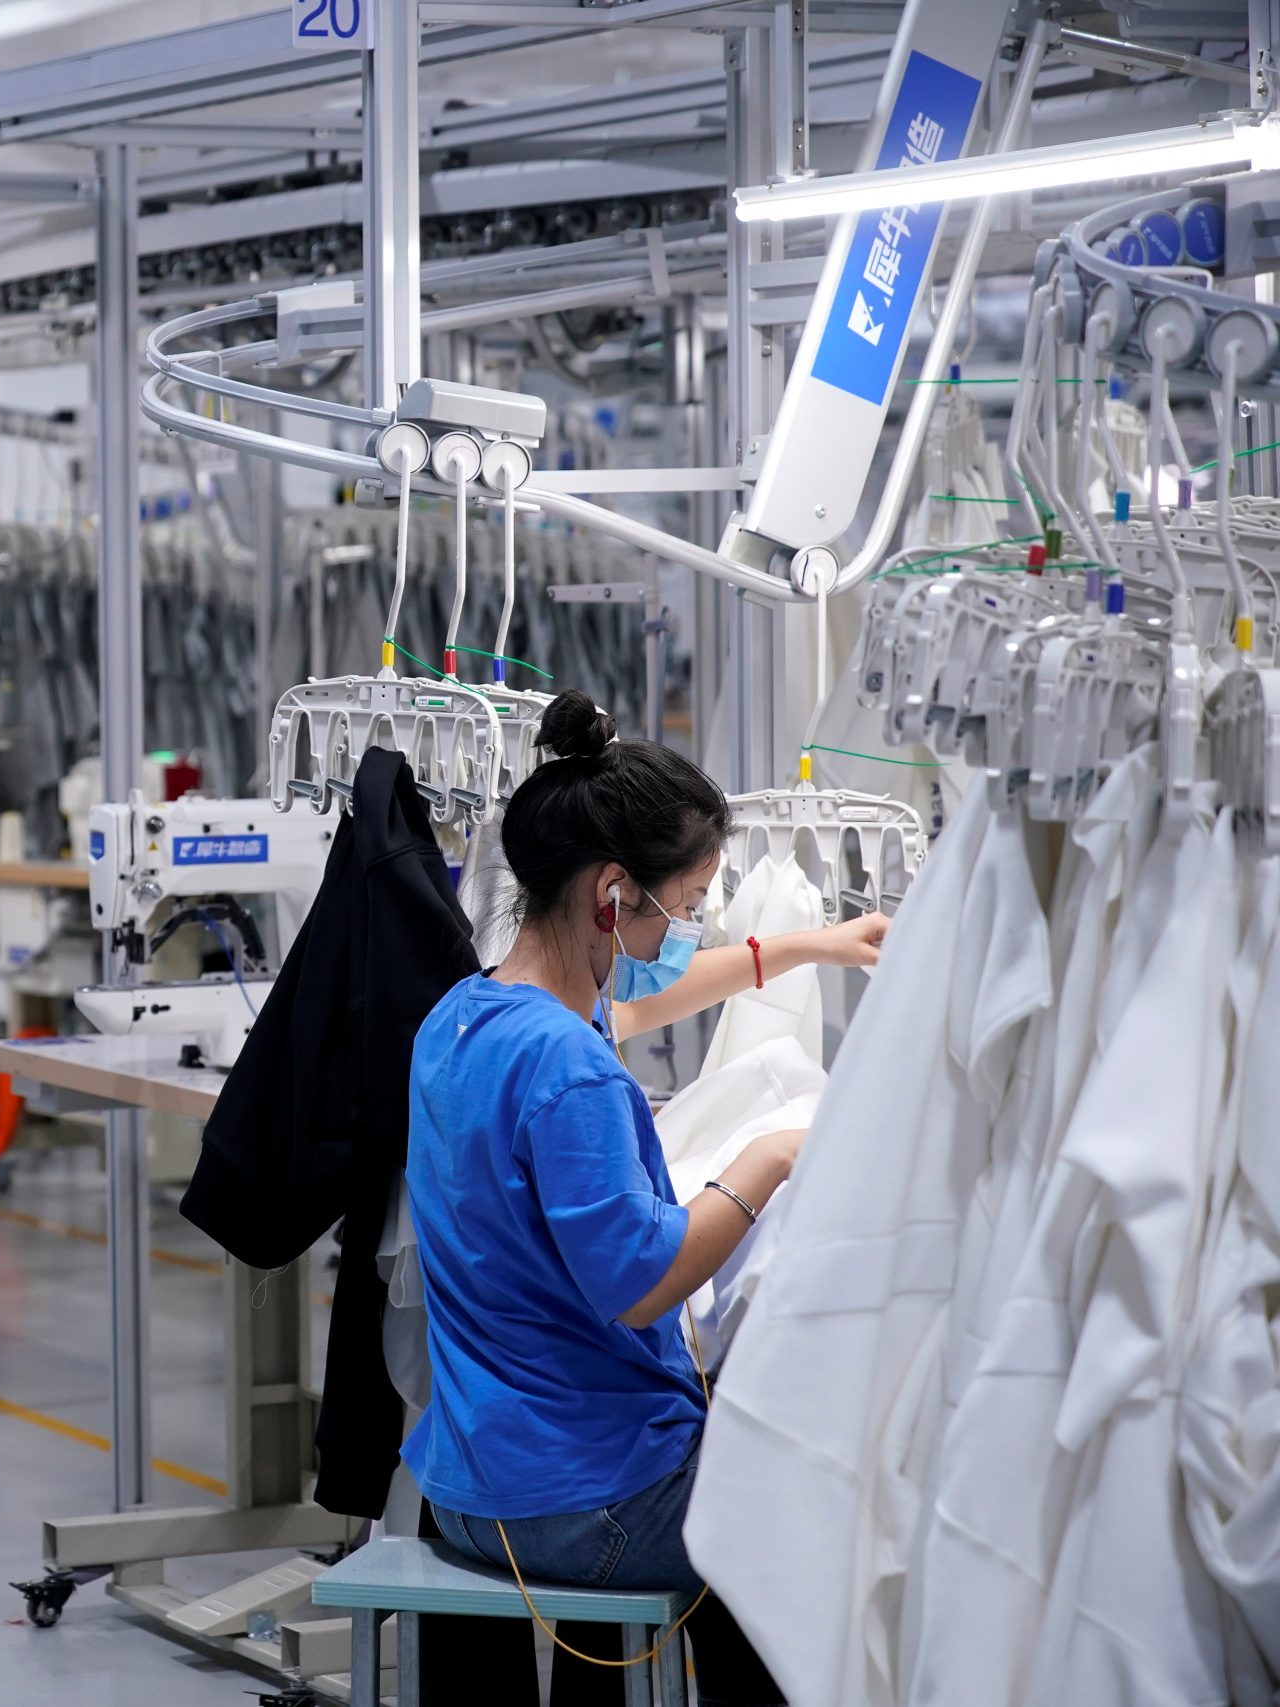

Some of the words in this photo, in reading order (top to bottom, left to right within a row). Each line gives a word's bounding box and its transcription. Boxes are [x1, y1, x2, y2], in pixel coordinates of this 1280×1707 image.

[298, 0, 360, 38] 20
[862, 111, 945, 297] 犀牛造
